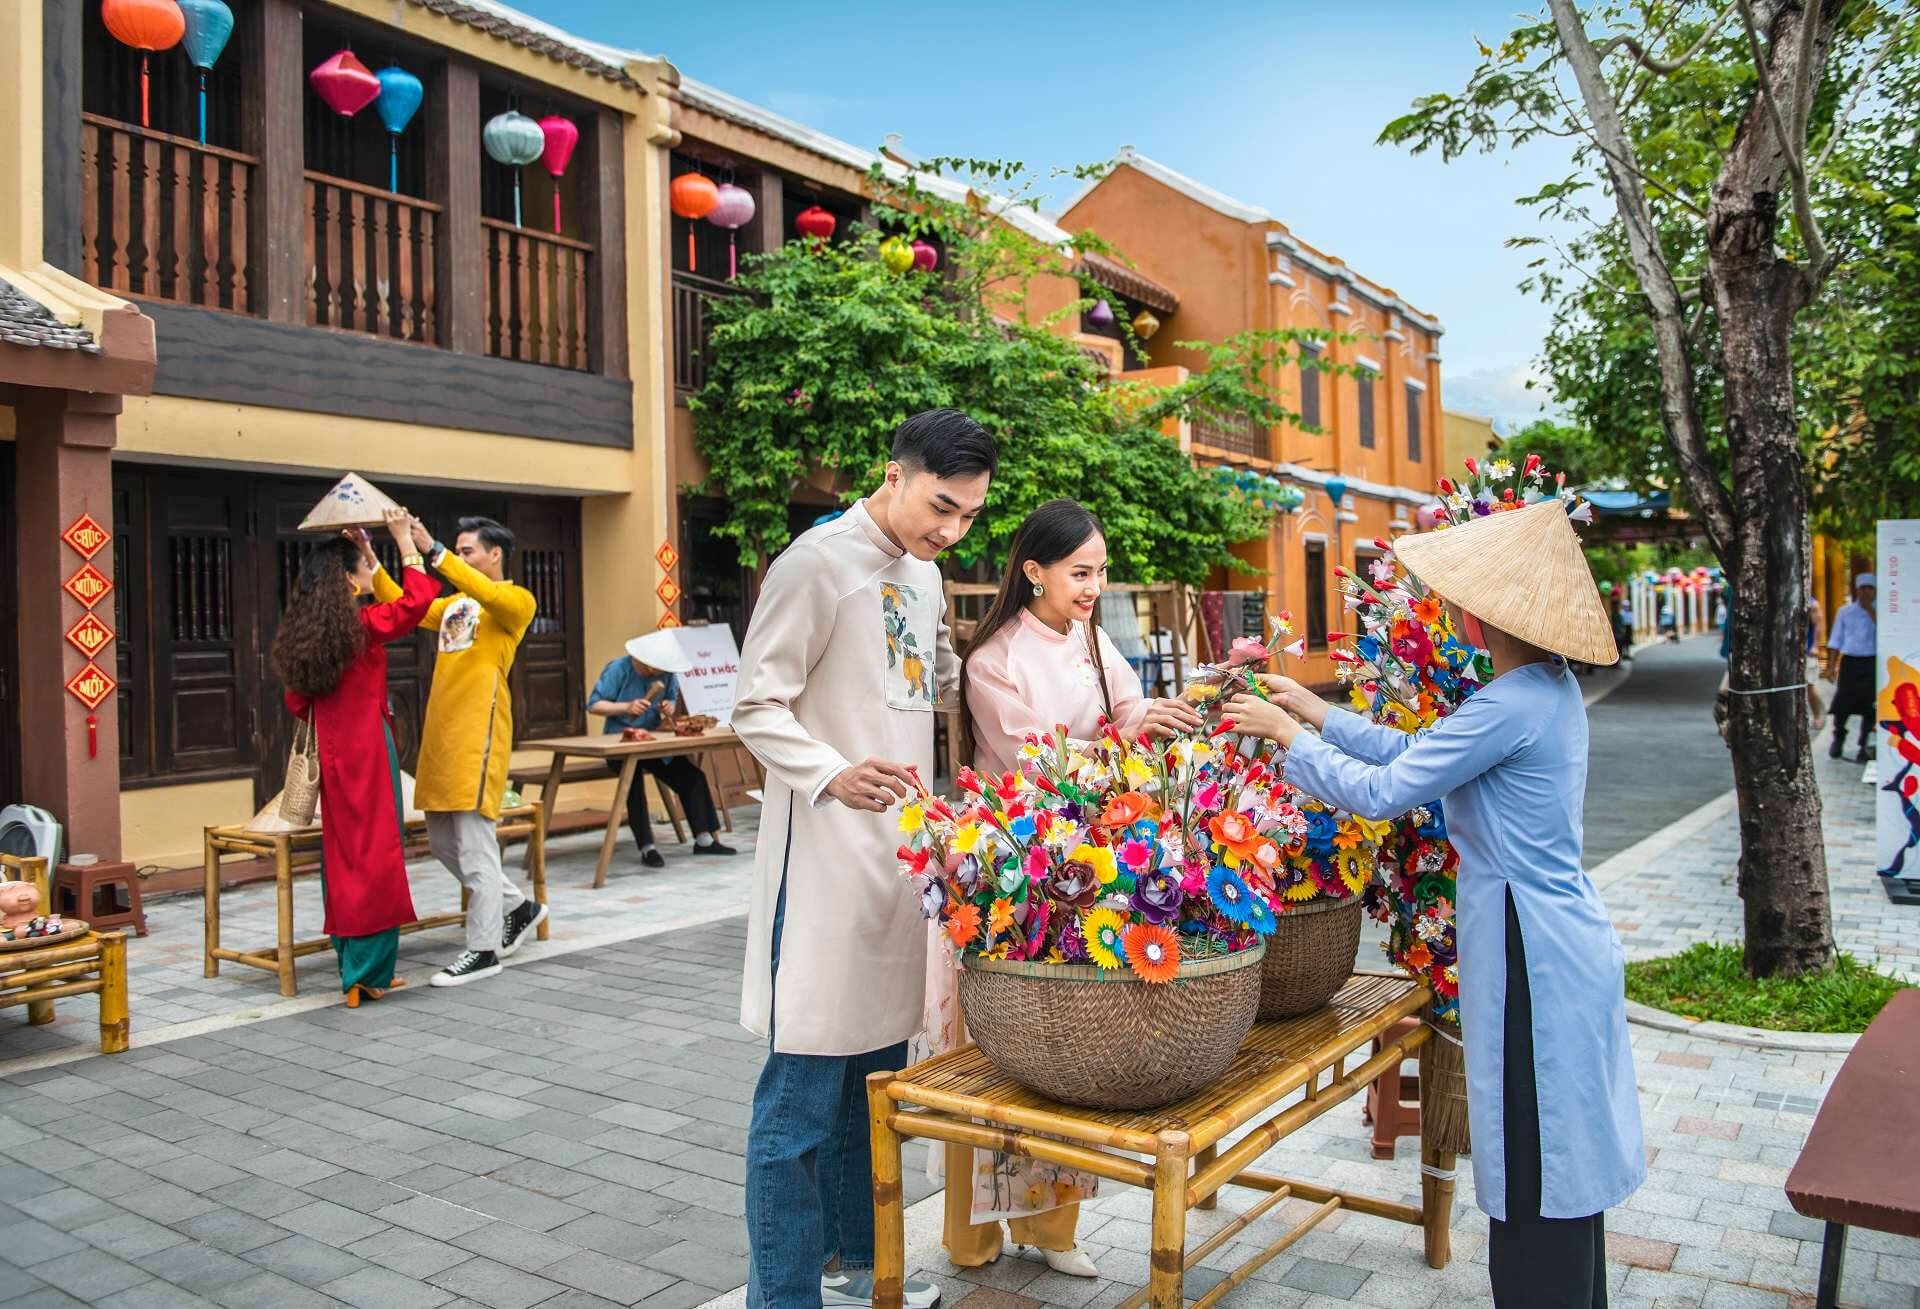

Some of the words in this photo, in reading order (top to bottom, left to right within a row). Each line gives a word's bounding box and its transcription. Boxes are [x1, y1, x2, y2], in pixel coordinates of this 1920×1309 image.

[74, 525, 102, 548] CHÚC
[75, 573, 103, 597] MỪNG
[78, 621, 103, 648] NĂM
[79, 674, 104, 697] MỚI
